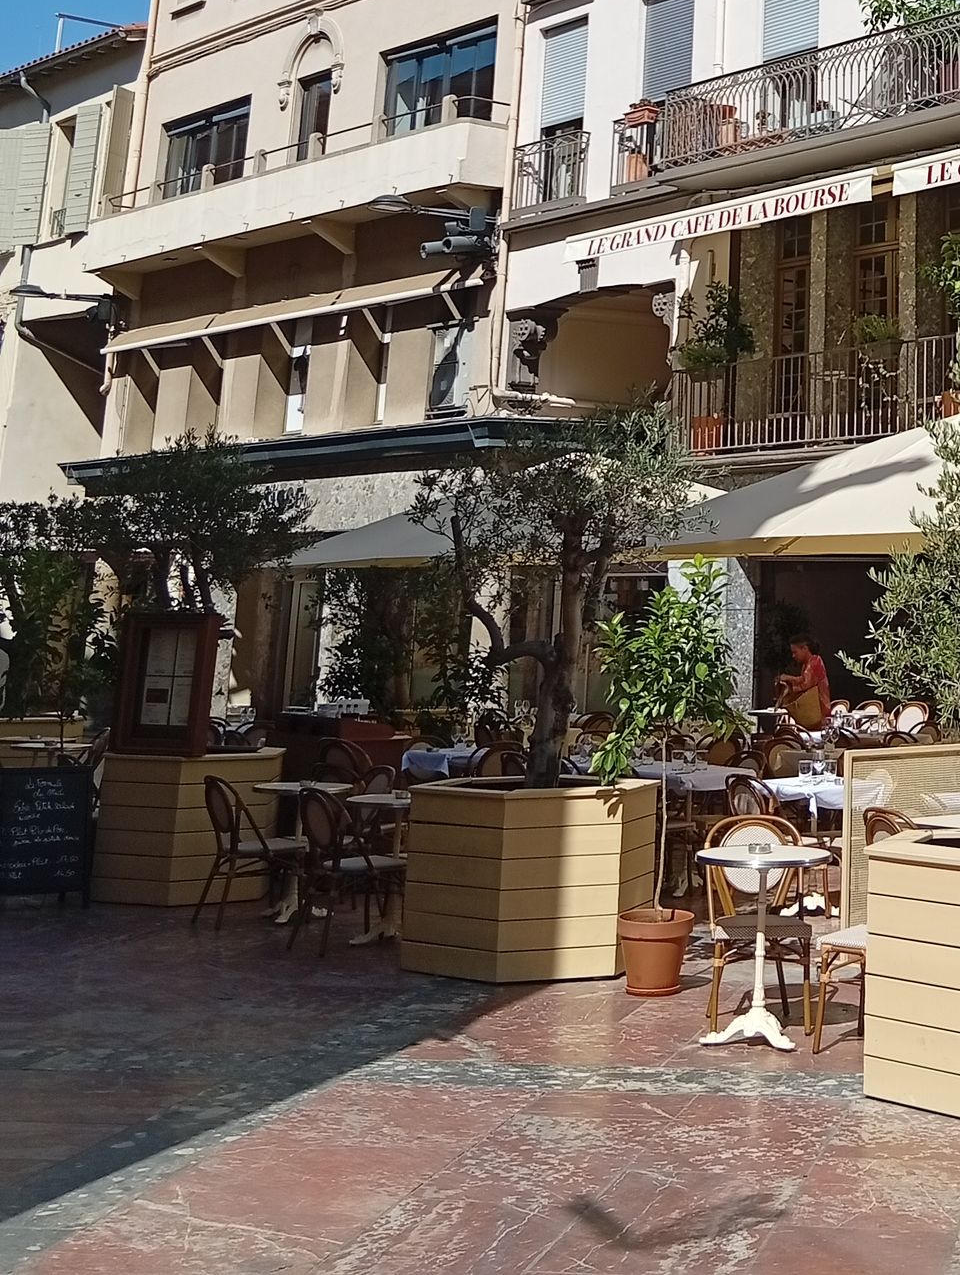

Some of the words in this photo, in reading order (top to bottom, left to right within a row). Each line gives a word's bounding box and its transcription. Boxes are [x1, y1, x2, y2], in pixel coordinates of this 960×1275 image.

[926, 160, 953, 186] LE
[587, 236, 608, 257] LE
[609, 224, 667, 252] GRAND
[671, 212, 715, 239] CAFE
[718, 206, 743, 229] DE
[747, 201, 769, 223] LA
[773, 182, 851, 217] BOURSE
